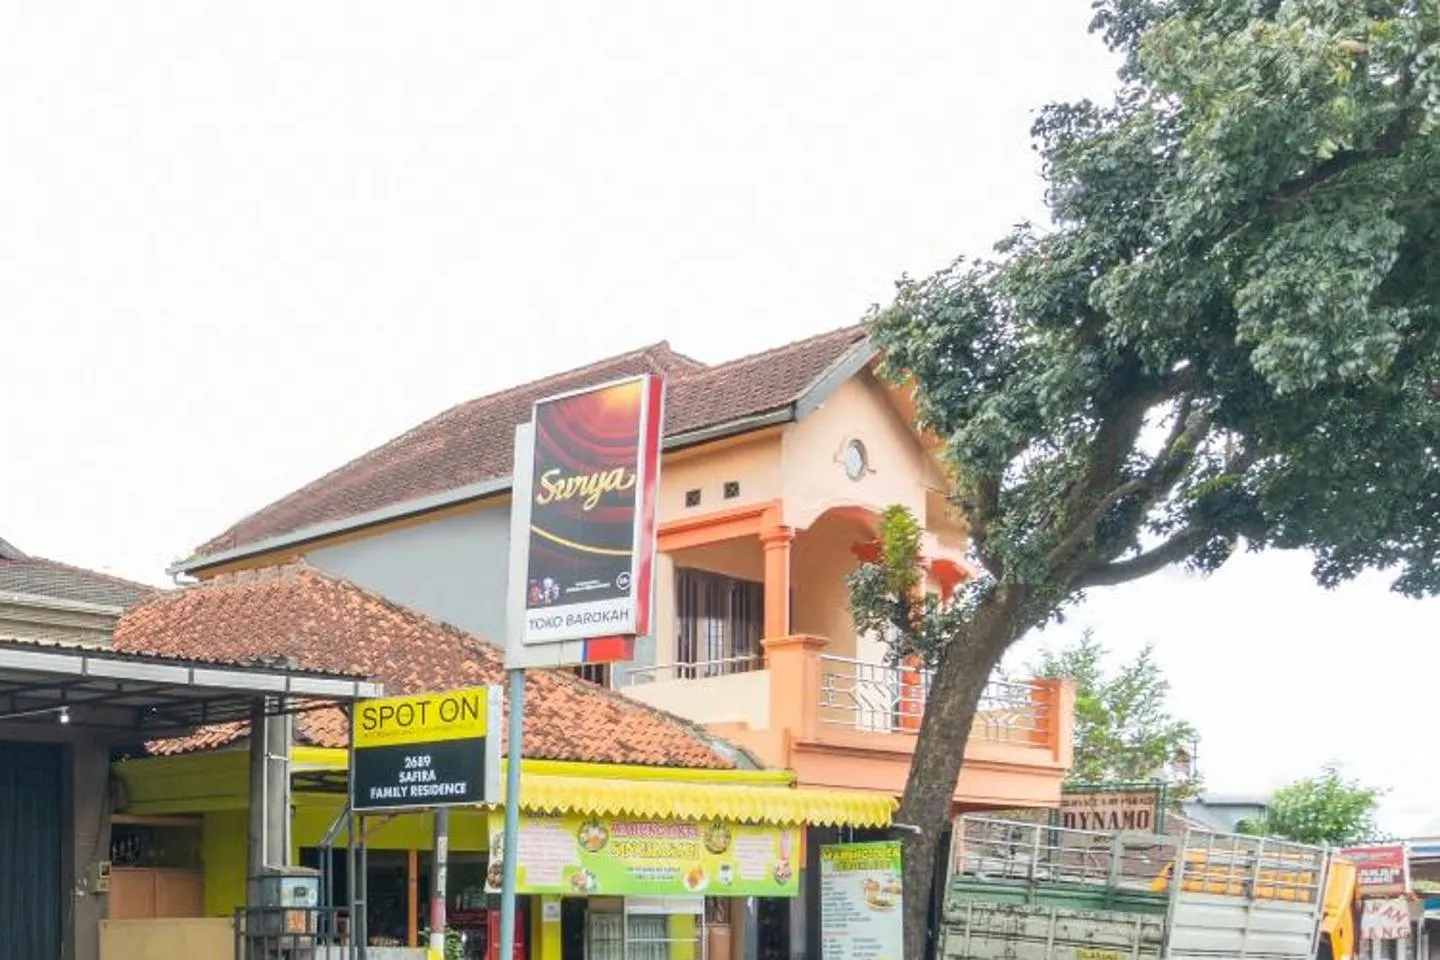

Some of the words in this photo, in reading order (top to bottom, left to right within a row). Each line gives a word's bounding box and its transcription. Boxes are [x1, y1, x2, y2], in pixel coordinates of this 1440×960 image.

[535, 466, 636, 511] Surya
[529, 615, 564, 631] TOKO
[565, 608, 629, 627] BAROKAH
[362, 700, 431, 731] SPOT
[439, 695, 479, 723] ON
[404, 755, 431, 769] 2689
[398, 769, 437, 783] SAFIRA
[369, 785, 408, 799] FAMILY
[410, 782, 468, 797] RESIDENCE
[1063, 809, 1150, 830] DYNAMO
